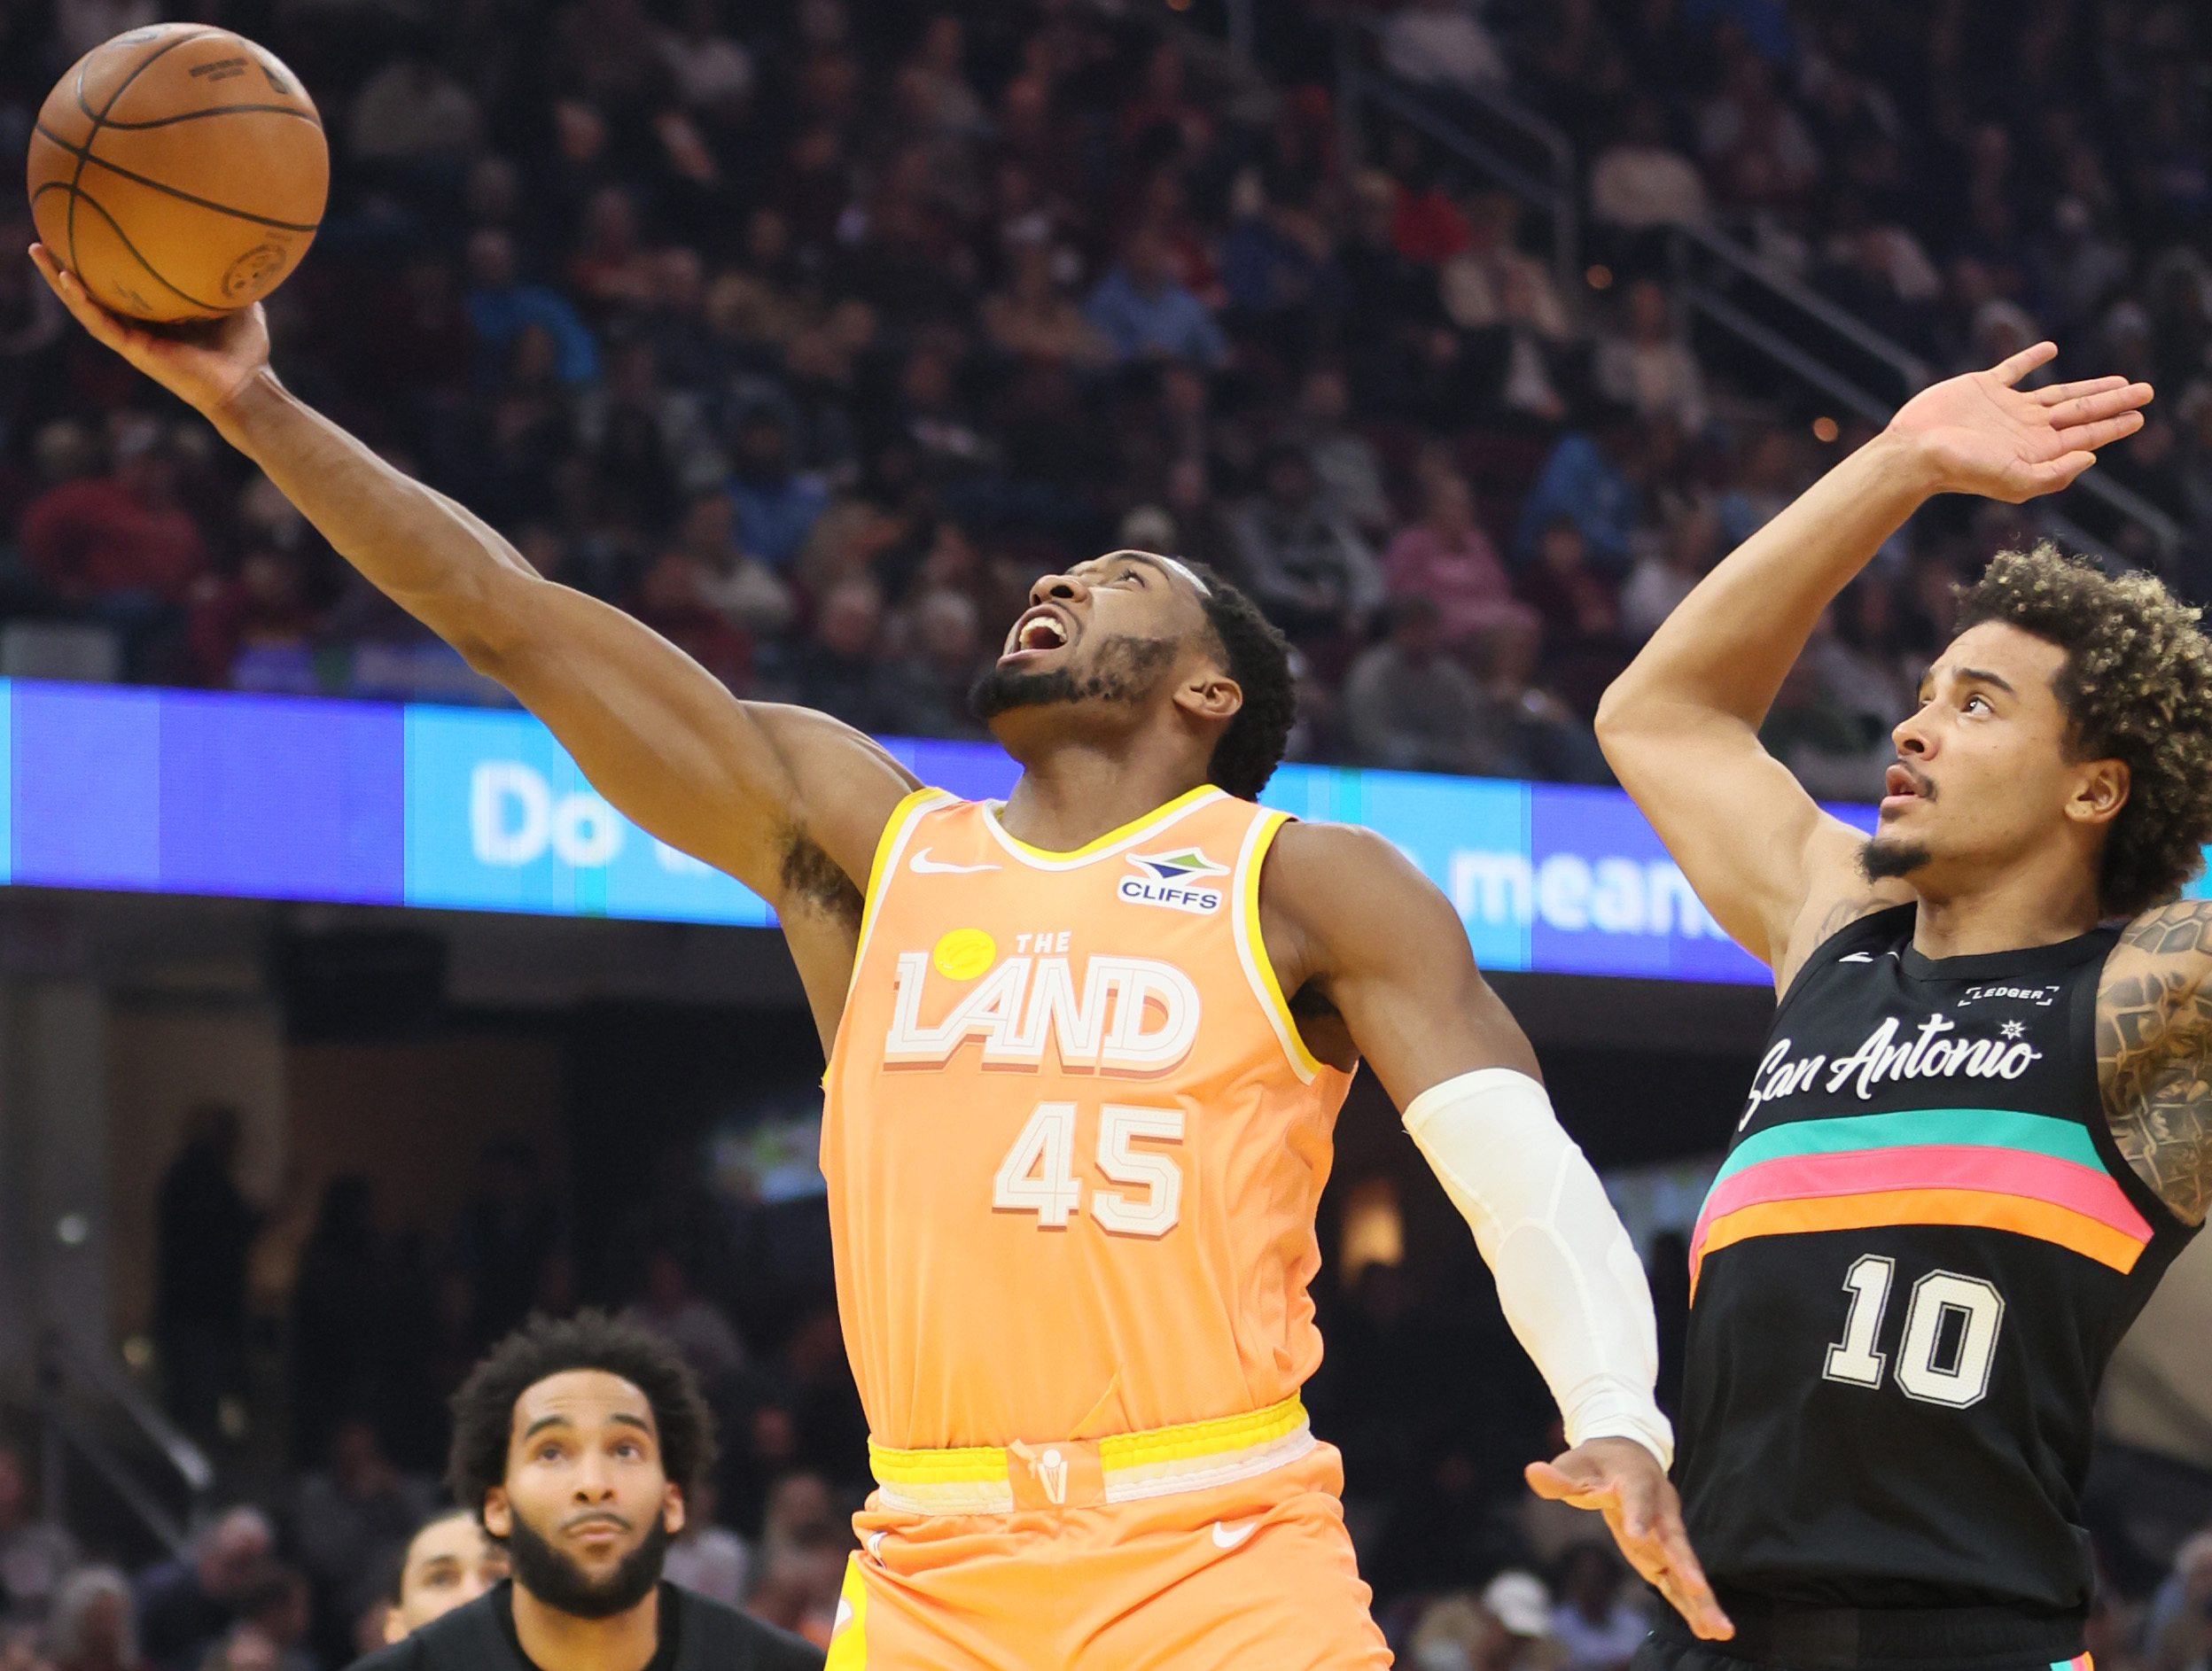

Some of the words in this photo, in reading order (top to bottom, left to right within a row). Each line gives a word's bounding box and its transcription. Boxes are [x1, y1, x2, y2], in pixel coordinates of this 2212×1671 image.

[469, 759, 623, 868] Do
[1448, 850, 1729, 943] mean
[1122, 882, 1219, 909] CLIFFS
[1016, 930, 1072, 954] THE
[1972, 987, 2045, 999] LEDGER
[883, 950, 1201, 1079] LAND
[1738, 1037, 1826, 1132] San
[1826, 1012, 2043, 1100] Antonio
[992, 1100, 1188, 1241] 45
[1821, 1253, 2006, 1410] 10
